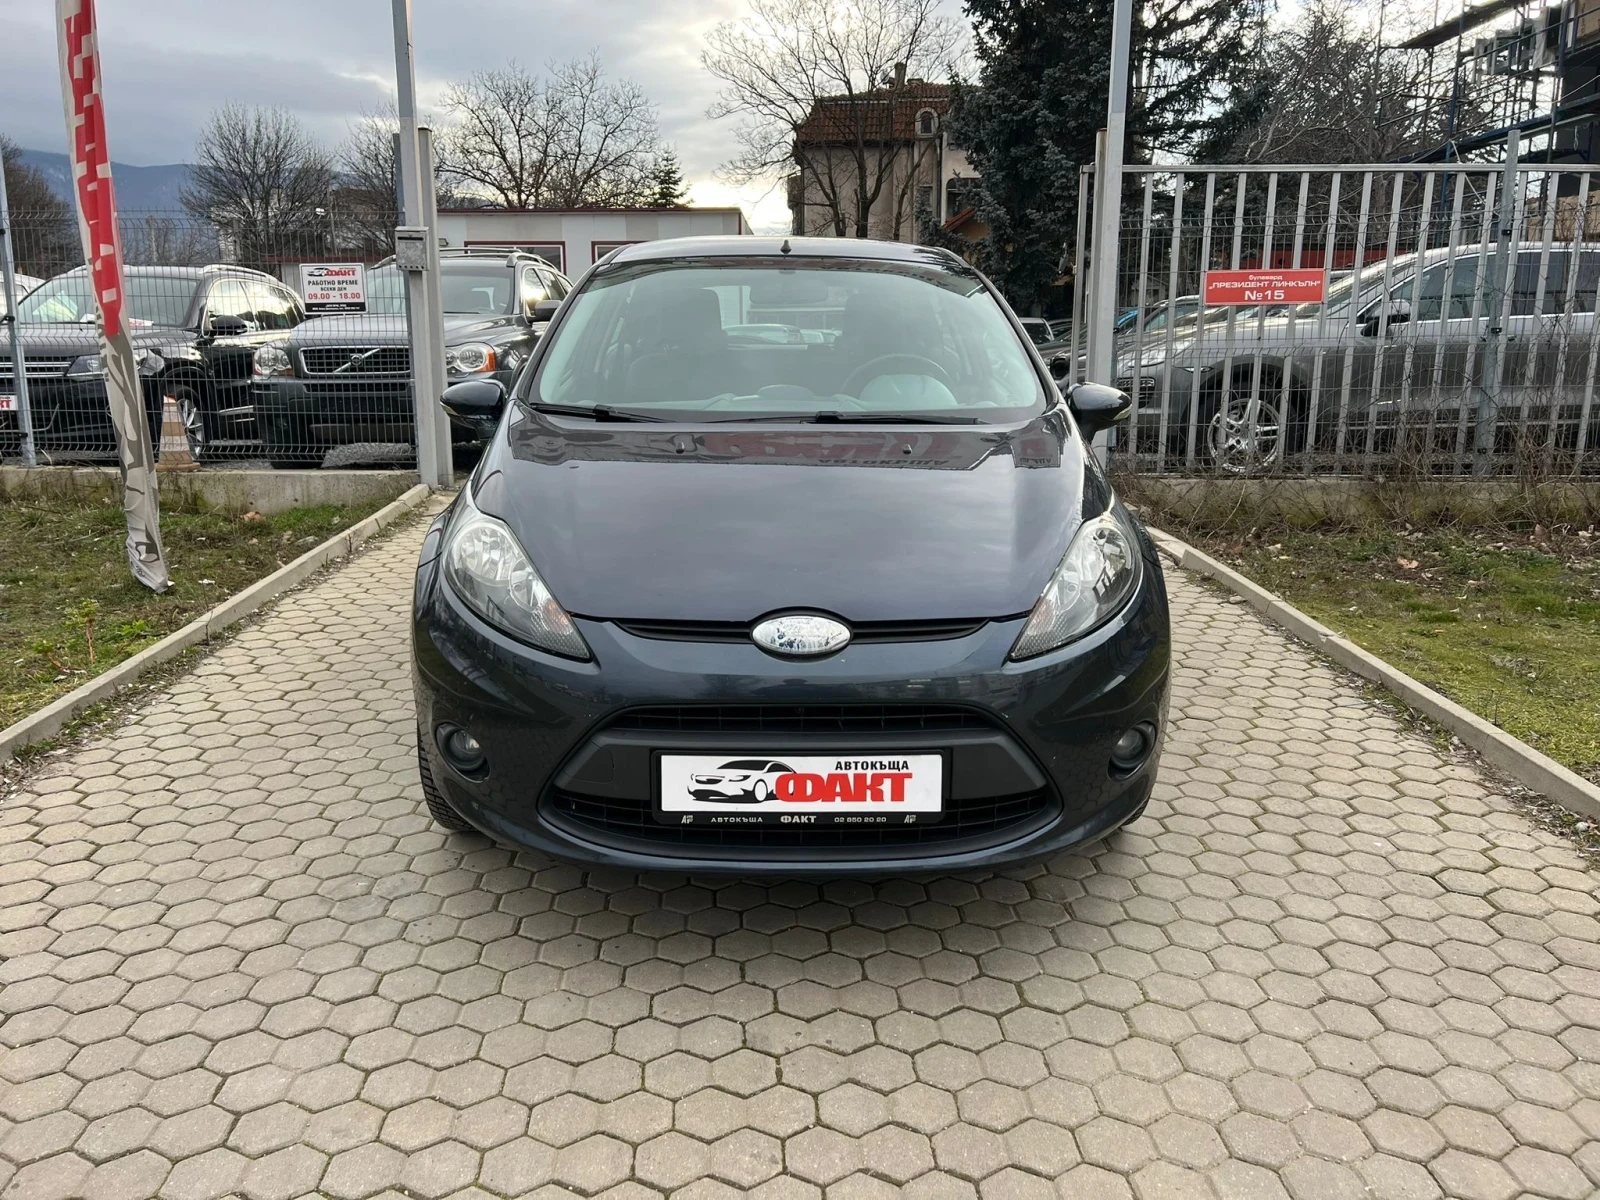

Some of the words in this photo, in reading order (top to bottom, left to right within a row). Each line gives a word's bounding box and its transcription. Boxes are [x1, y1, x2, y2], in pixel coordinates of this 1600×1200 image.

[1244, 290, 1285, 301] №15
[834, 760, 909, 772] АВТОКЪЩА
[774, 772, 913, 803] ФАКТ
[780, 815, 817, 824] ФАКТ
